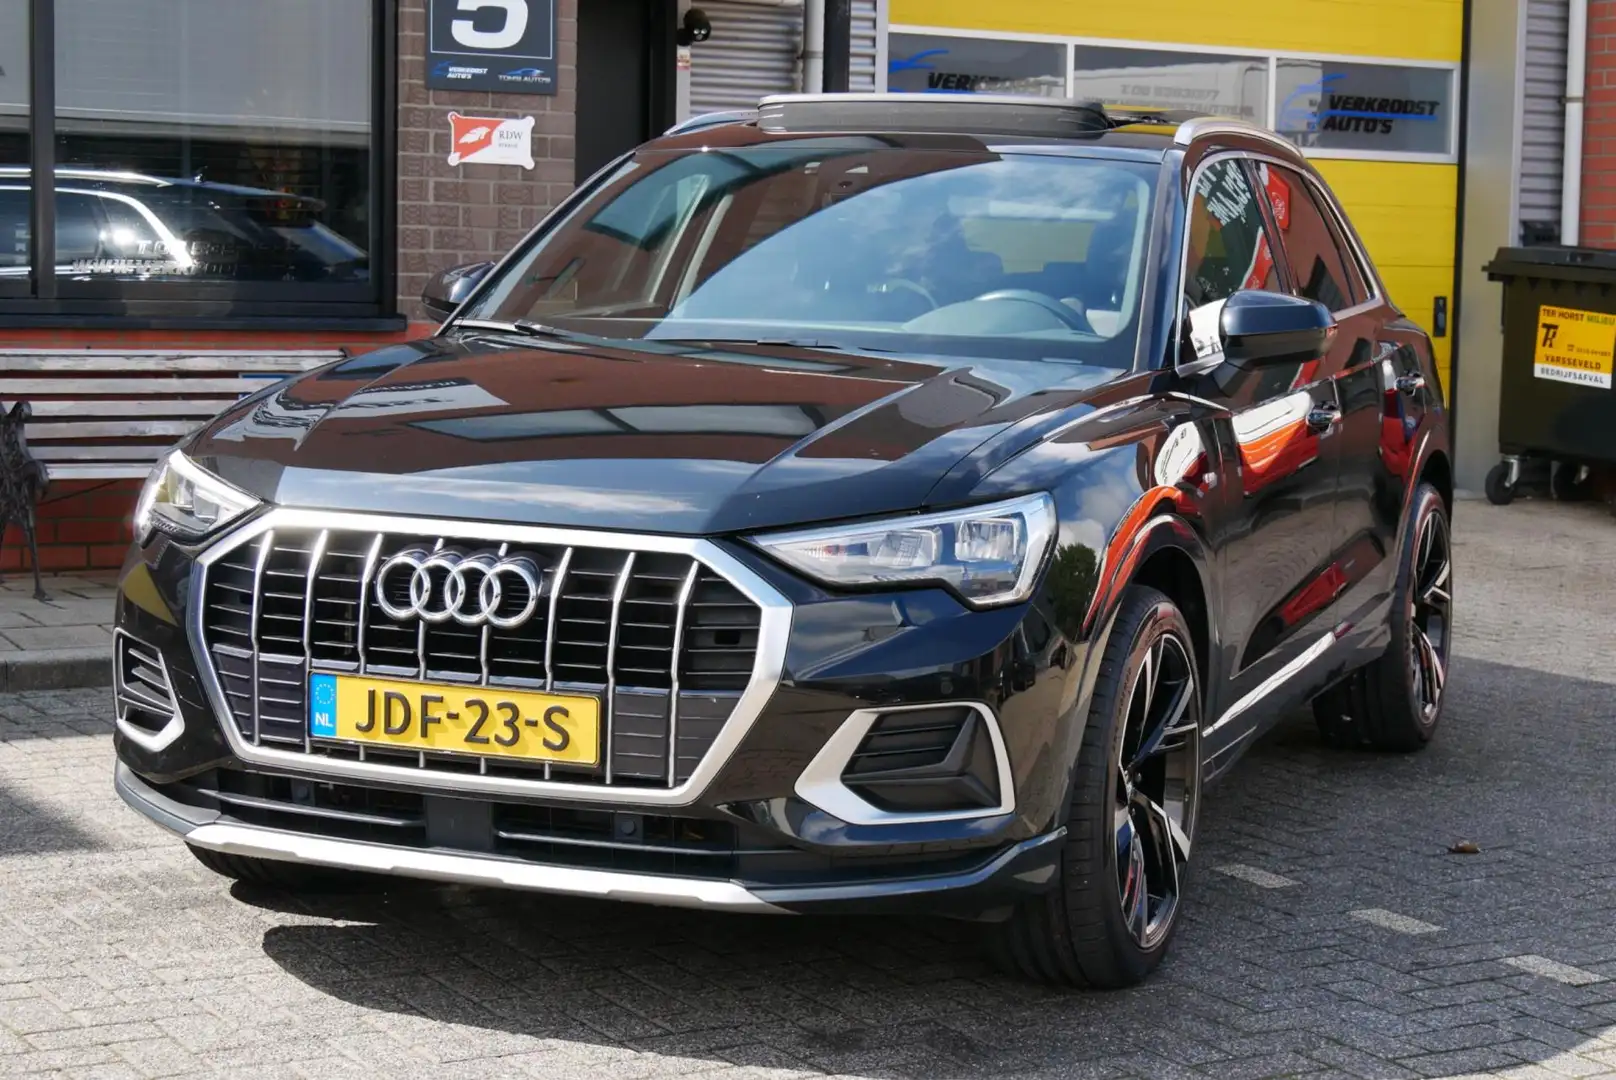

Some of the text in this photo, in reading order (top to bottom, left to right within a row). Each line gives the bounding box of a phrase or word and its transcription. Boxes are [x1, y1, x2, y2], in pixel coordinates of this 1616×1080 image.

[451, 0, 529, 49] 5
[1329, 94, 1440, 115] VERKROOST
[1322, 116, 1393, 134] AUTO'S
[499, 130, 523, 141] RDW
[1542, 308, 1616, 326] TER HORST MILIEU
[1544, 354, 1601, 370] VARSSEVELD
[1540, 367, 1604, 384] BEDRIJFSAFVAL
[315, 712, 334, 728] NL
[355, 689, 570, 751] JDF-23-S
